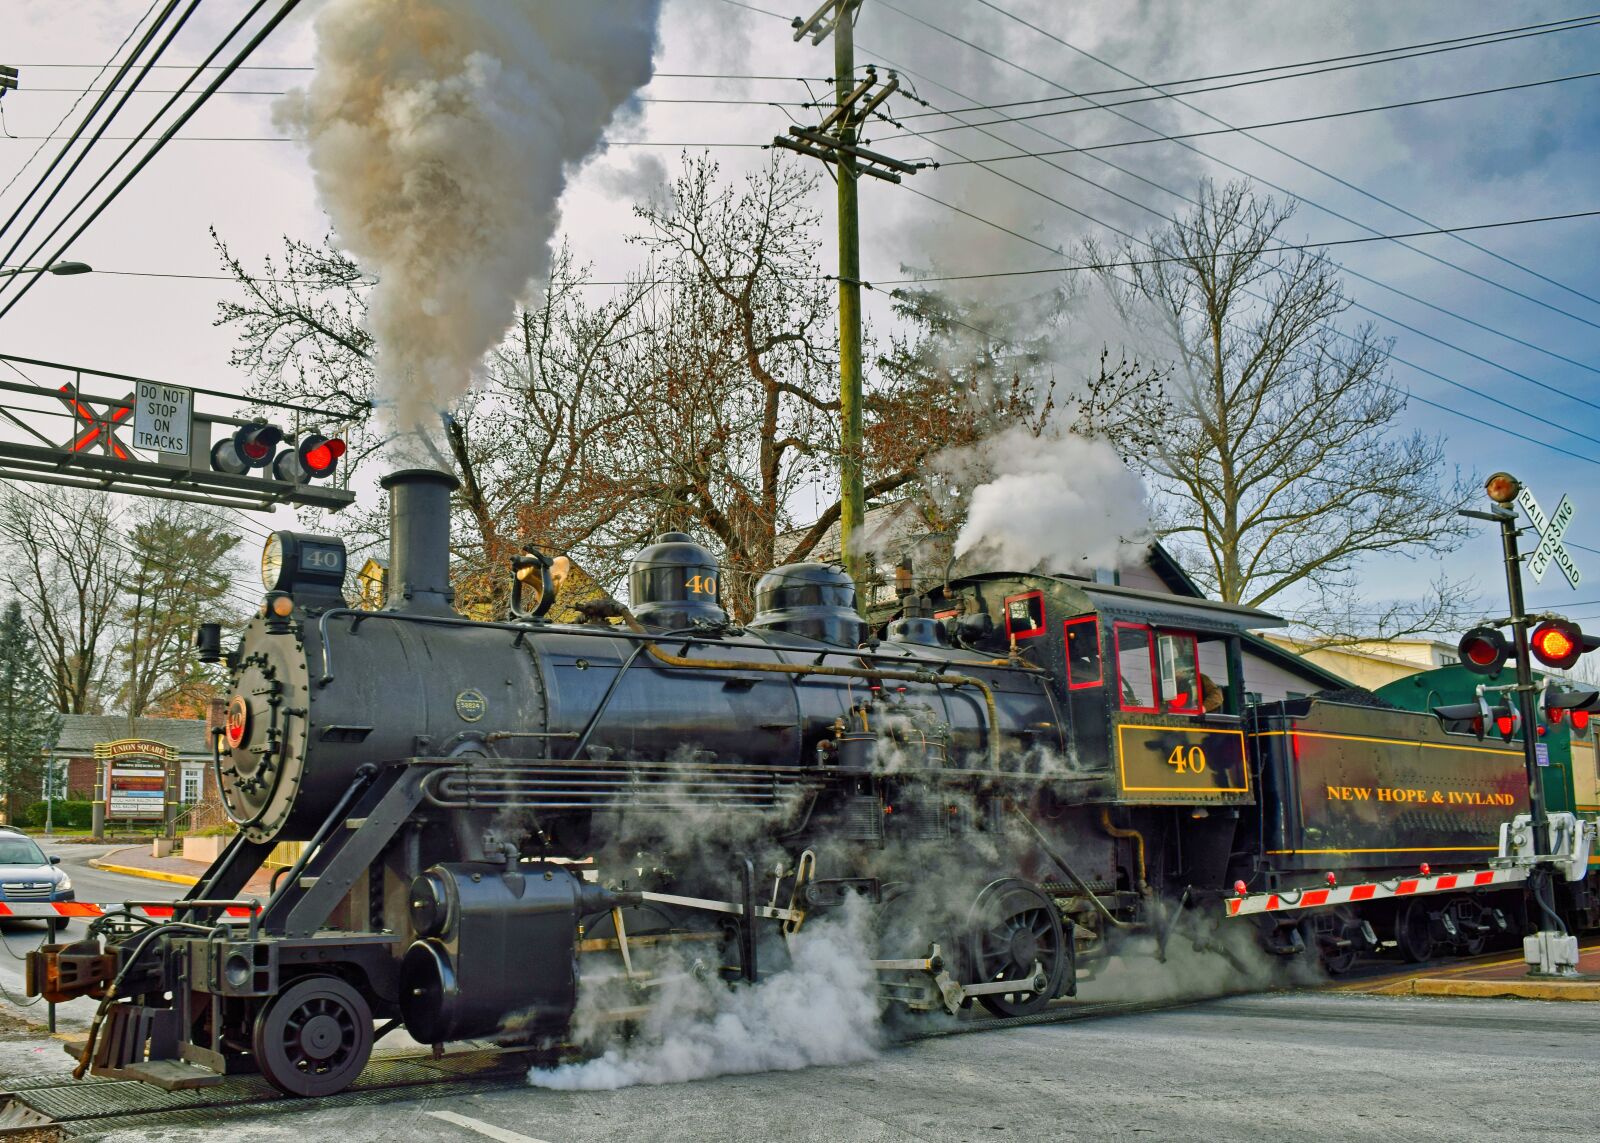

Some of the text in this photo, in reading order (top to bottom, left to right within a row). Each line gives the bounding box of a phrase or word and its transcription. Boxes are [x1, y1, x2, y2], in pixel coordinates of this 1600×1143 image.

[141, 385, 185, 404] DO NOT
[148, 402, 177, 418] STOP
[154, 418, 170, 433] ON
[138, 431, 183, 451] TRACKS
[1521, 491, 1580, 583] RAIL ROAD
[1533, 502, 1572, 574] CROSSING
[306, 551, 338, 568] 40
[684, 575, 717, 595] 40
[112, 743, 165, 756] UNION SQUARE
[1167, 745, 1206, 774] 40
[1327, 786, 1515, 806] NEW HOPE & IVYLAND
